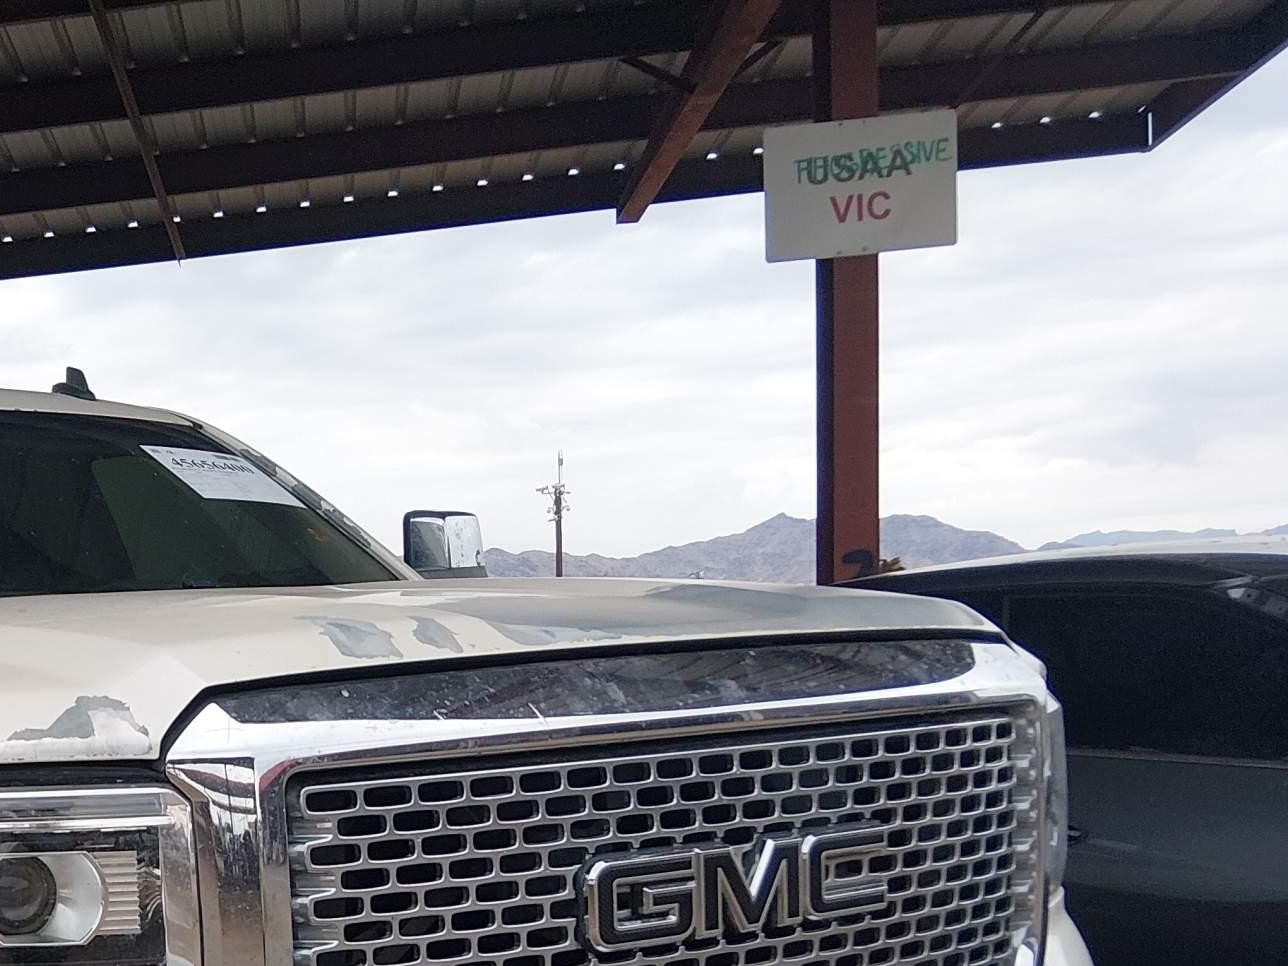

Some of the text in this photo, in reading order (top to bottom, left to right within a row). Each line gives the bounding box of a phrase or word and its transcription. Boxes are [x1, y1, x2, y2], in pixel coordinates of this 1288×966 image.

[828, 191, 892, 224] VIC
[171, 457, 256, 475] 45656400
[585, 827, 888, 952] GMC
